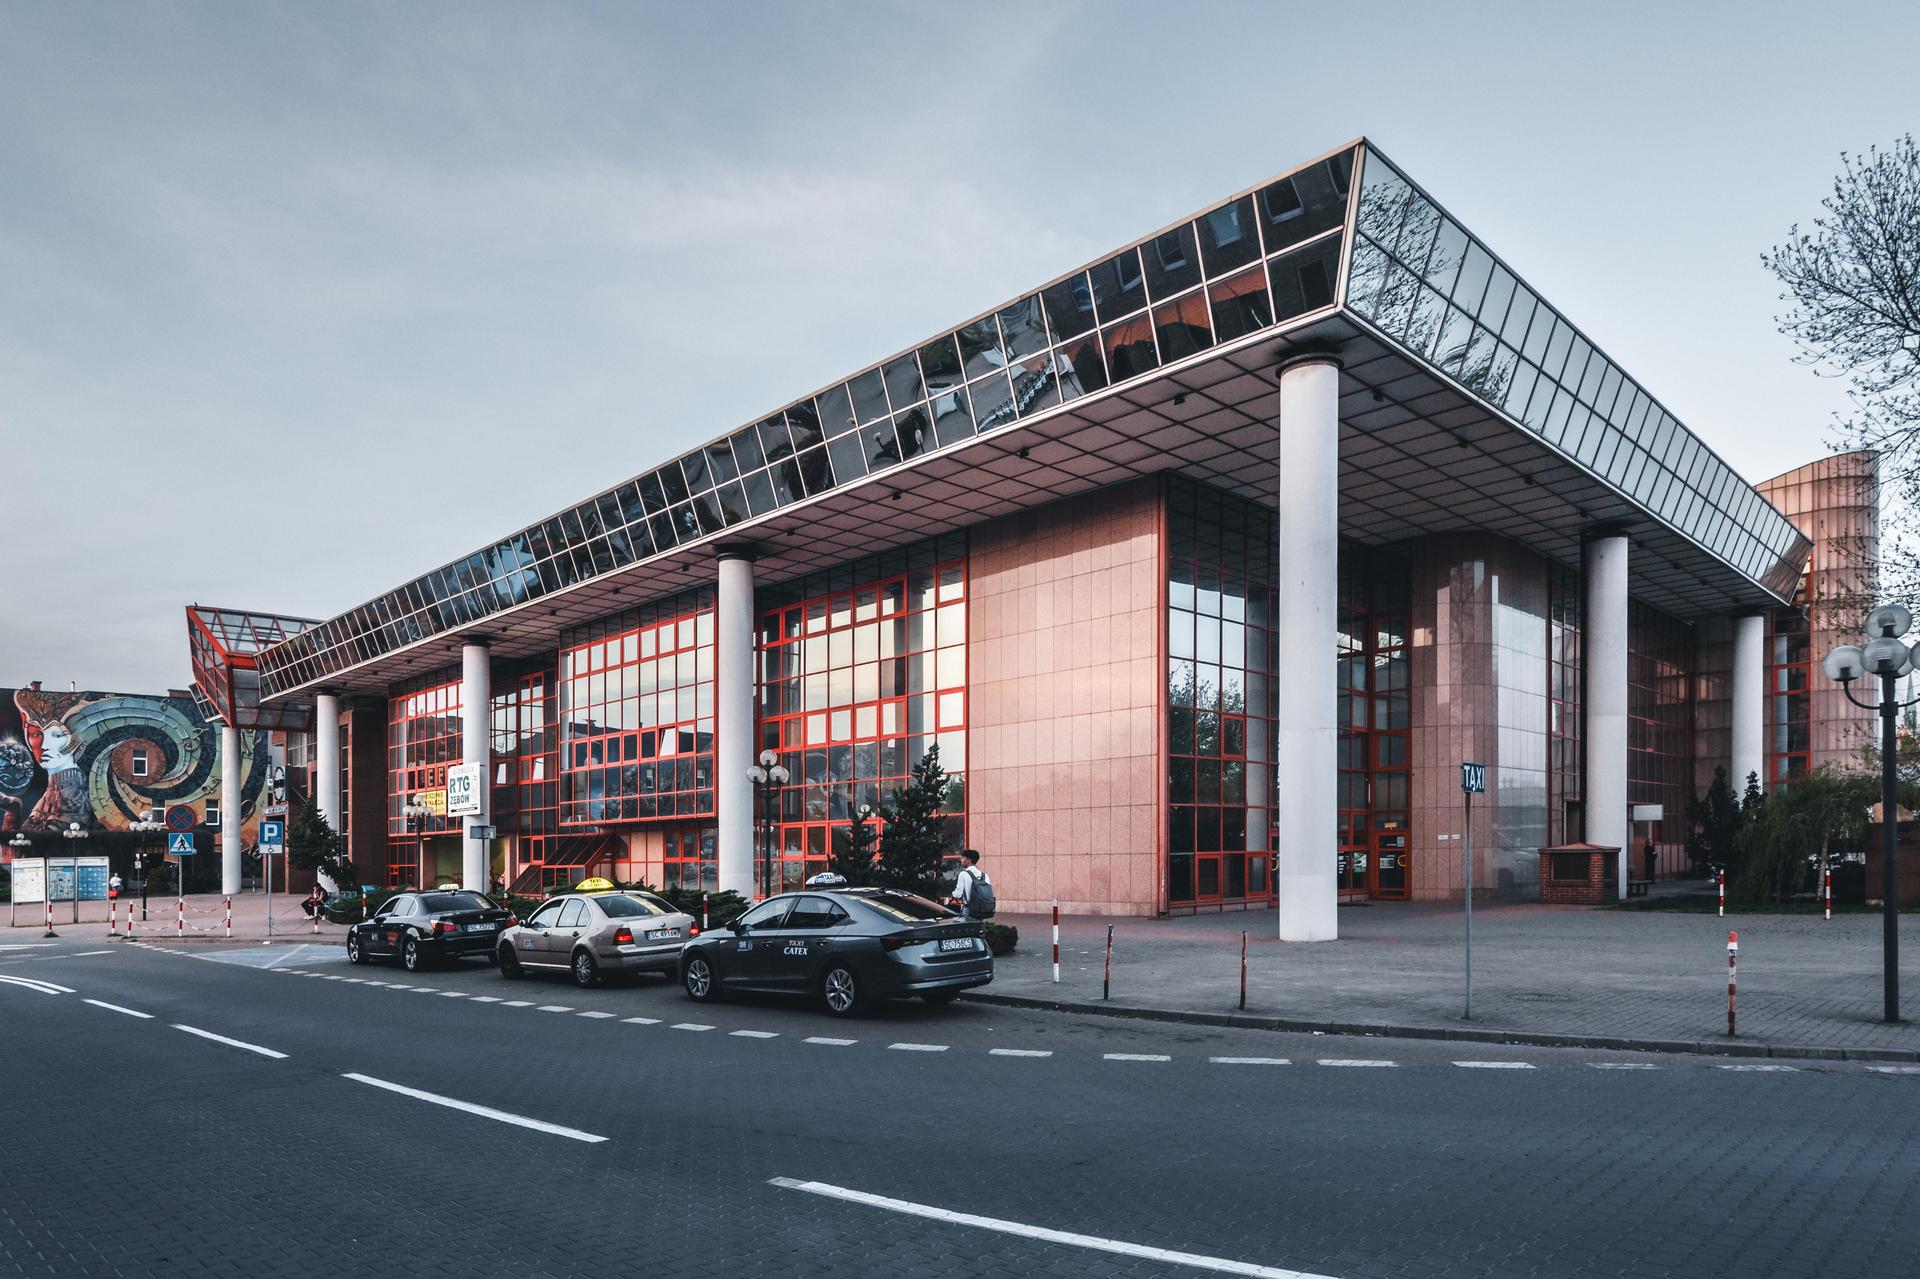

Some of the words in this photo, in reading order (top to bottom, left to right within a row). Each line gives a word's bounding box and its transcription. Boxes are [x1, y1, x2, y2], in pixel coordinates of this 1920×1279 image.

[449, 775, 470, 794] RTG
[1464, 765, 1484, 789] TAXI
[264, 823, 278, 842] P
[783, 947, 809, 955] CATEX
